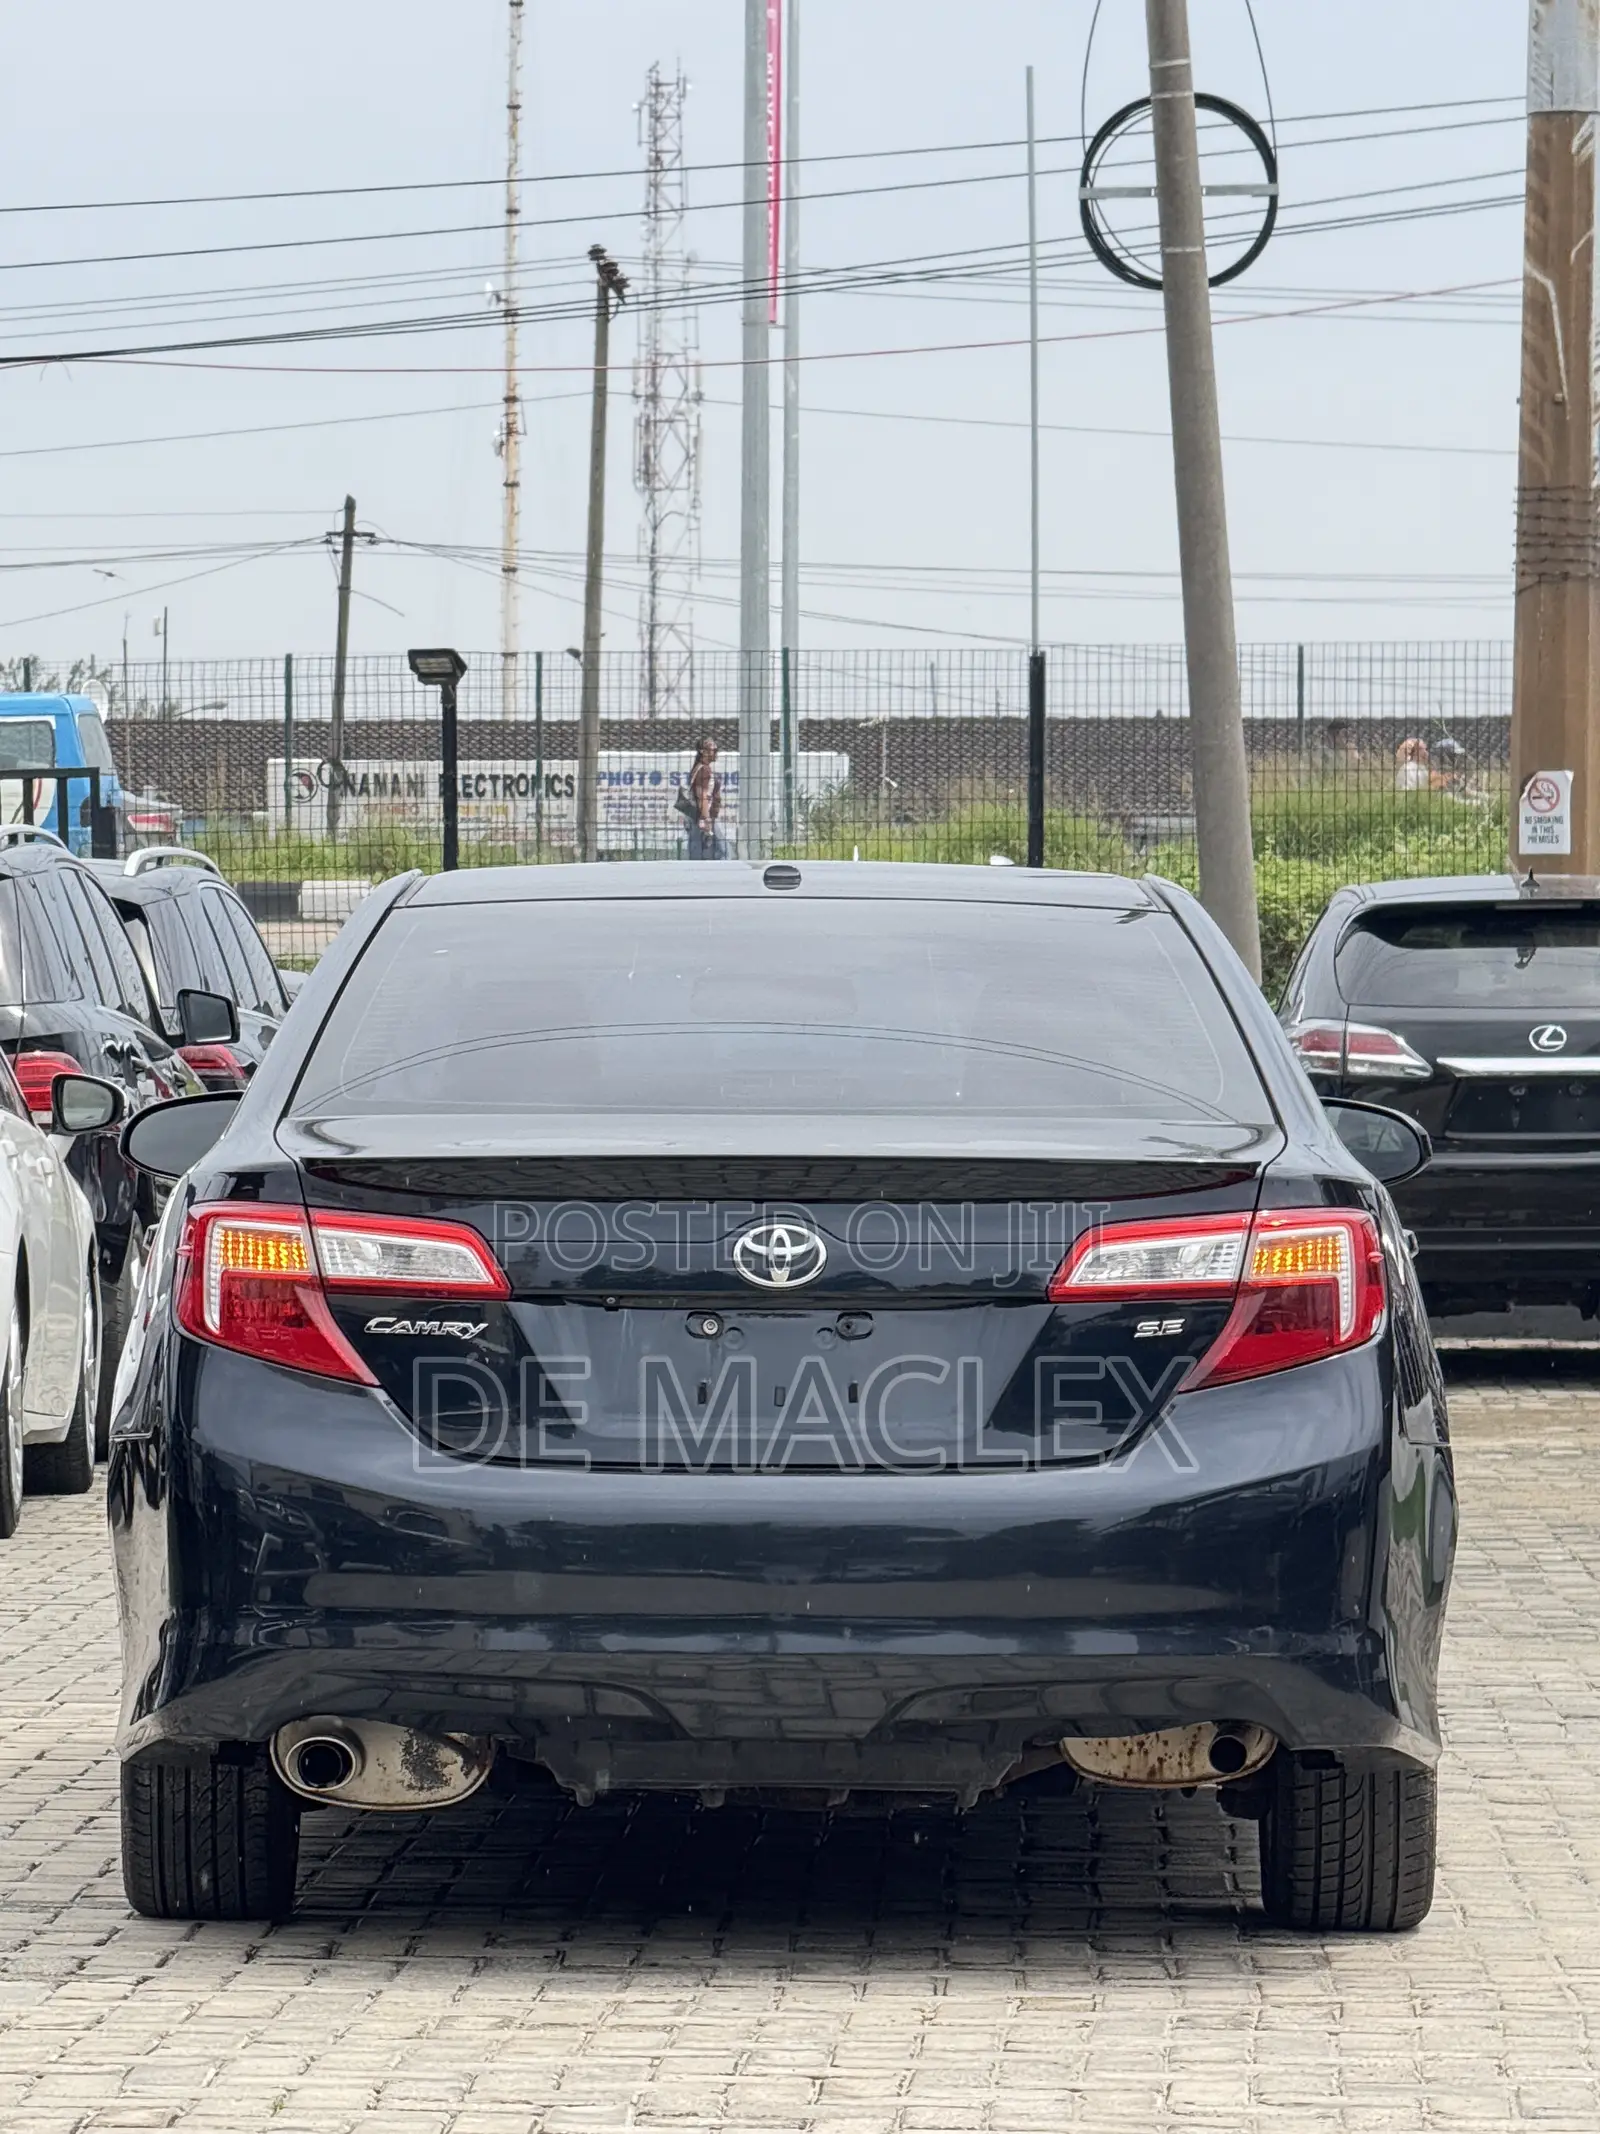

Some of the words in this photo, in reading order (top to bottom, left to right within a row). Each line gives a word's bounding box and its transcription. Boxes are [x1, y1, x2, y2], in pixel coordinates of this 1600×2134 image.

[438, 772, 575, 798] ECTRONICS
[1524, 816, 1533, 824] NO
[1533, 816, 1564, 825] SMOKING
[1540, 825, 1555, 834] THIS
[364, 1316, 489, 1340] CAMRY
[1134, 1318, 1187, 1338] SE
